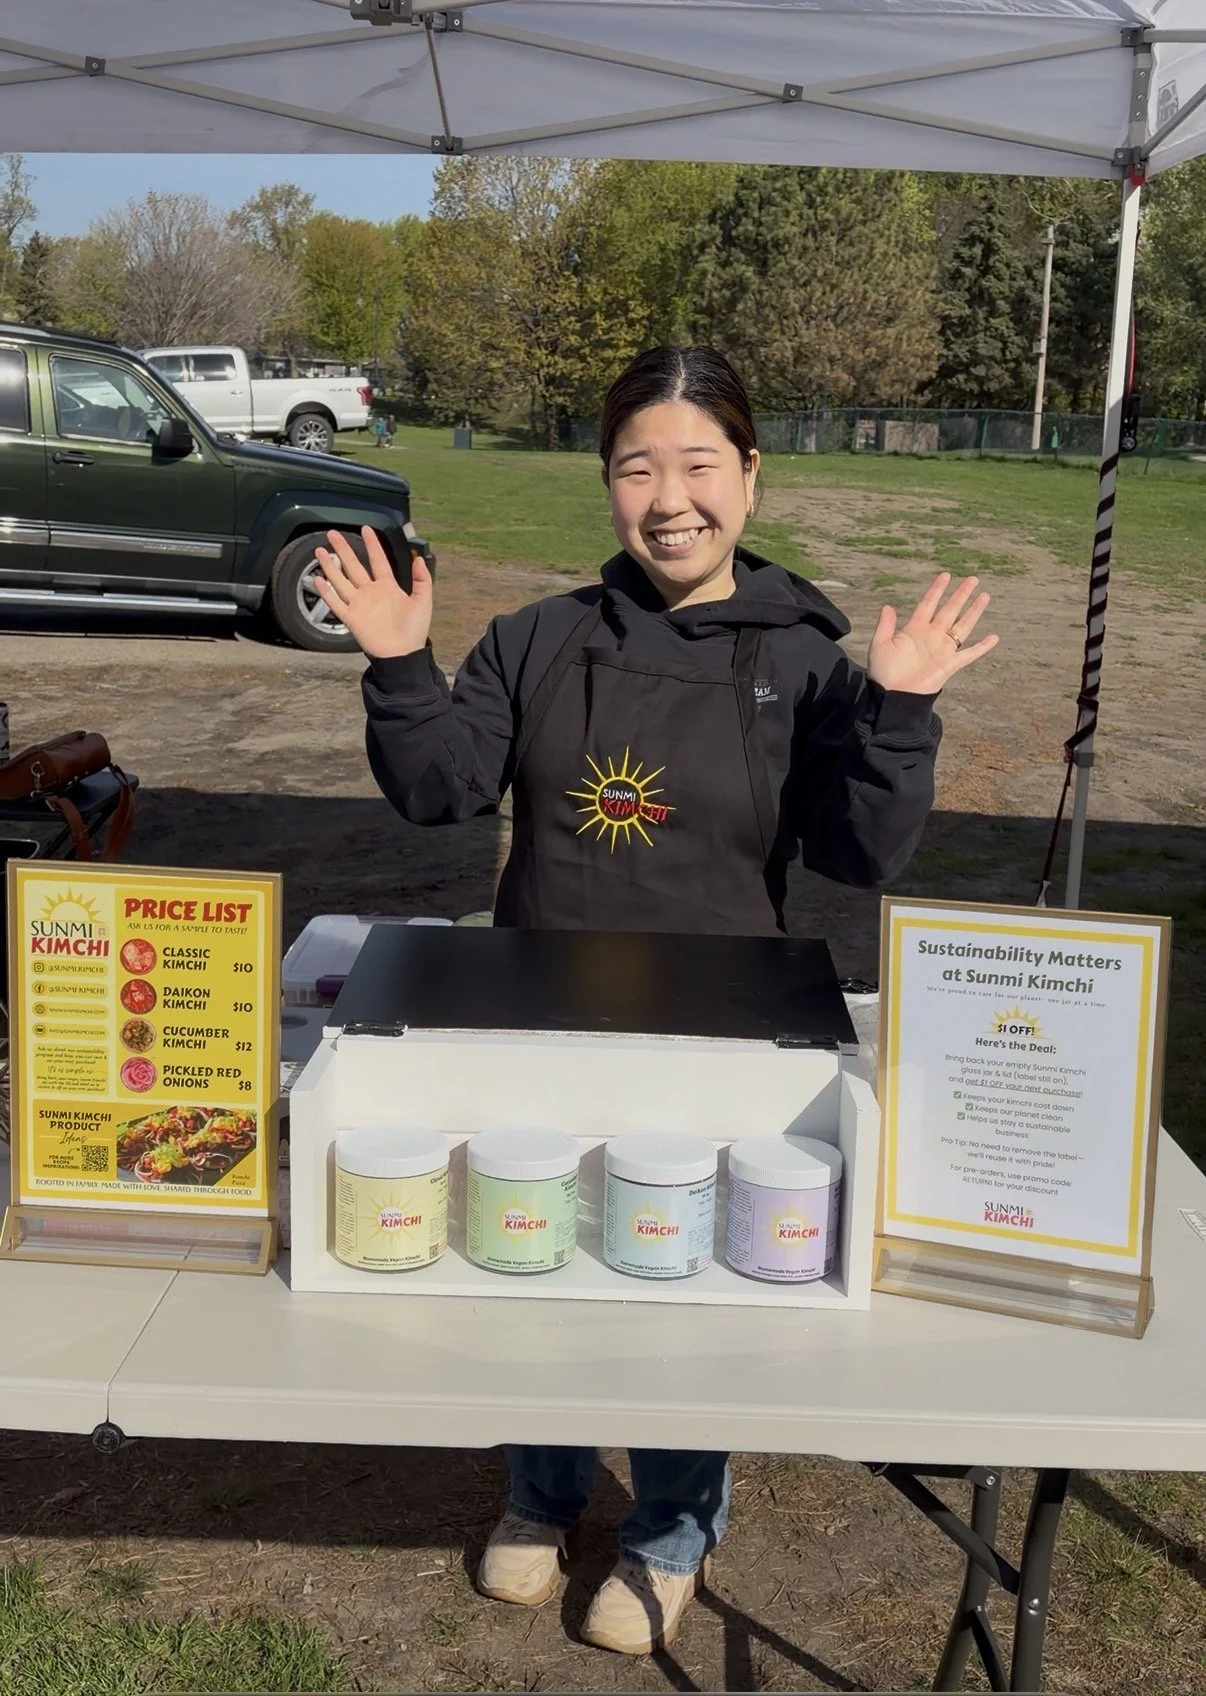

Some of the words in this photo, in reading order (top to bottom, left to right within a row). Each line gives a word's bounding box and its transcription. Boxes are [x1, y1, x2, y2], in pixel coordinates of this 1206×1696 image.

[602, 789, 636, 802] SUNMI
[603, 799, 668, 822] KIMCHI
[123, 898, 198, 921] PRICE
[202, 902, 253, 924] LIST
[31, 921, 92, 938] SUNMI
[181, 925, 209, 933] SAMPLE
[224, 927, 248, 935] TASTE!
[31, 937, 110, 957] KIMCHI
[162, 947, 211, 959] CLASSIC
[918, 940, 1044, 967] Sustainability
[1048, 951, 1122, 970] Matters
[162, 960, 207, 971] KIMCHI
[233, 962, 253, 973] $10
[942, 969, 962, 982] at
[966, 969, 1023, 987] Sunmi
[1027, 975, 1094, 994] Kimchi
[163, 987, 211, 998] DAIKON
[163, 999, 206, 1011] KIMCHI
[233, 1002, 253, 1013] $10
[162, 1026, 230, 1039] CUCUMBER
[997, 1024, 1007, 1033] $1
[1009, 1025, 1035, 1036] OFF!
[163, 1038, 206, 1050] KIMCHI
[235, 1041, 252, 1052] $12
[975, 1038, 1006, 1049] Here's
[1009, 1041, 1026, 1051] the
[1029, 1043, 1057, 1054] Deal:
[945, 1054, 965, 1064] Bring
[966, 1056, 985, 1064] back
[1006, 1061, 1031, 1071] empty
[1033, 1064, 1057, 1073] Sunmi
[1059, 1067, 1087, 1076] Kimchi
[163, 1065, 214, 1077] PICKLED
[216, 1068, 241, 1079] RED
[961, 1067, 982, 1075] glass
[983, 1068, 993, 1077] jar
[1014, 1071, 1036, 1080] (label
[1038, 1075, 1051, 1083] still
[1053, 1077, 1069, 1086] on),
[163, 1077, 209, 1089] ONIONS
[238, 1081, 252, 1092] $8
[965, 1078, 979, 1086] get
[989, 1080, 1004, 1088] OFF
[1006, 1083, 1023, 1091] your
[1043, 1088, 1083, 1098] purchase!
[963, 1094, 986, 1103] Keeps
[988, 1096, 1005, 1104] your
[1006, 1098, 1032, 1107] kimchi
[1033, 1102, 1051, 1110] cost
[1052, 1103, 1074, 1112] down
[39, 1110, 72, 1120] SUNMI
[73, 1112, 112, 1122] KIMCHI
[974, 1105, 998, 1114] Keeps
[1014, 1110, 1040, 1119] planet
[1041, 1112, 1063, 1122] clean
[50, 1121, 101, 1131] PRODUCT
[967, 1114, 988, 1124] Helps
[1000, 1119, 1016, 1128] stay
[1026, 1122, 1071, 1133] sustainable
[59, 1132, 88, 1145] Ideas
[995, 1129, 1029, 1139] business
[1011, 1148, 1042, 1156] remove
[1032, 1160, 1056, 1169] pride!
[963, 1167, 1006, 1178] pre-orders,
[1023, 1175, 1049, 1184] promo
[1051, 1179, 1073, 1187] code:
[1025, 1185, 1058, 1195] discount
[984, 1201, 1024, 1216] SUNMI
[380, 1216, 422, 1228] KIMCHI
[504, 1220, 547, 1230] KIMCHI
[984, 1212, 1034, 1228] KIMCHI
[637, 1225, 679, 1236] KIMCHI
[779, 1228, 819, 1238] KIMCHI
